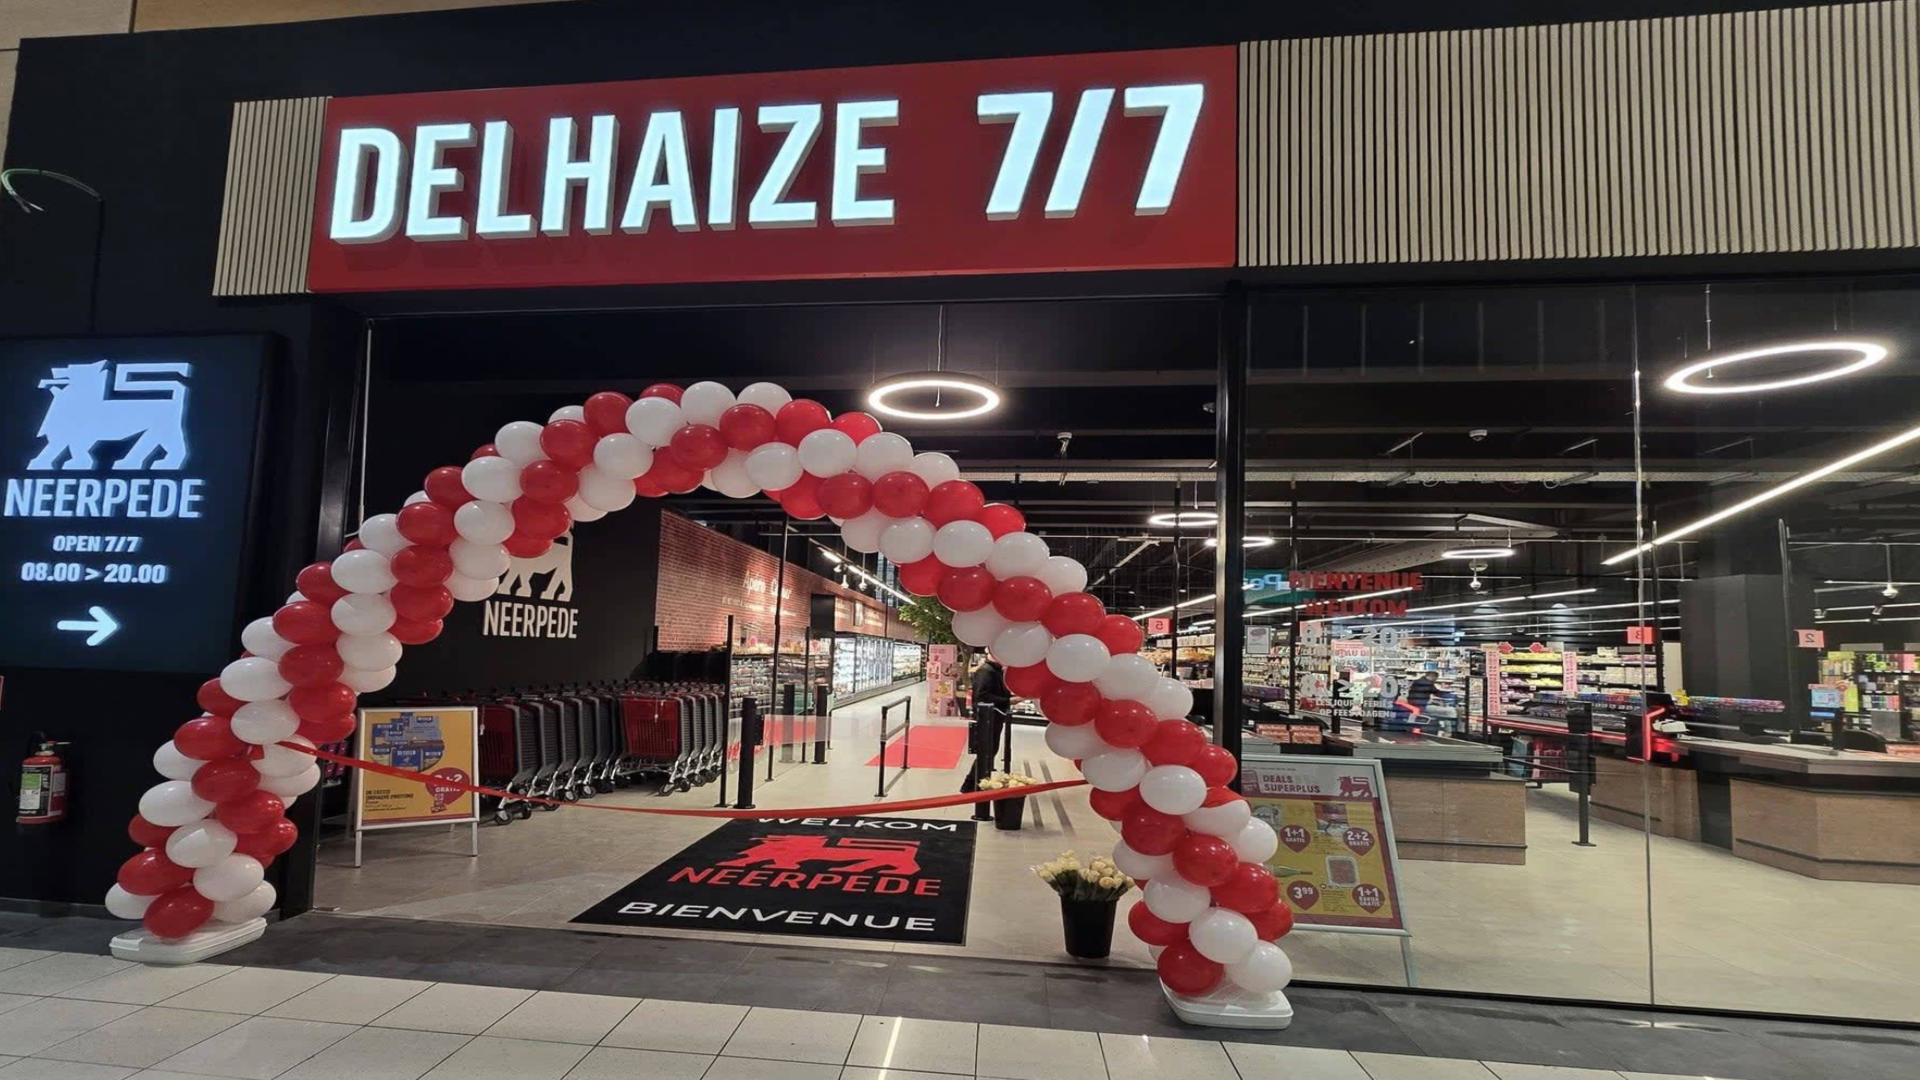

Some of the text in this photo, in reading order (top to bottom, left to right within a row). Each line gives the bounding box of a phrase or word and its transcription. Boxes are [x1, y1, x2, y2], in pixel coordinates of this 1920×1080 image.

[329, 83, 1205, 243] DELHAIZE 7/7
[4, 478, 204, 519] NEERPEDE
[53, 535, 142, 552] OPEN 7/7
[21, 562, 81, 582] 08.00
[104, 563, 167, 584] 20.00
[1289, 571, 1424, 591] BIENVENUE
[1304, 598, 1408, 618] WELKOM
[483, 600, 578, 638] NEERPEDE
[1262, 775, 1293, 784] DEALS
[1264, 784, 1321, 794] SUPERPLUS
[1284, 827, 1305, 838] 1+1
[1346, 831, 1370, 843] 2+2
[667, 867, 942, 897] NEERPEDE
[1357, 886, 1379, 897] 1+1
[617, 902, 936, 931] BIENVENUE
